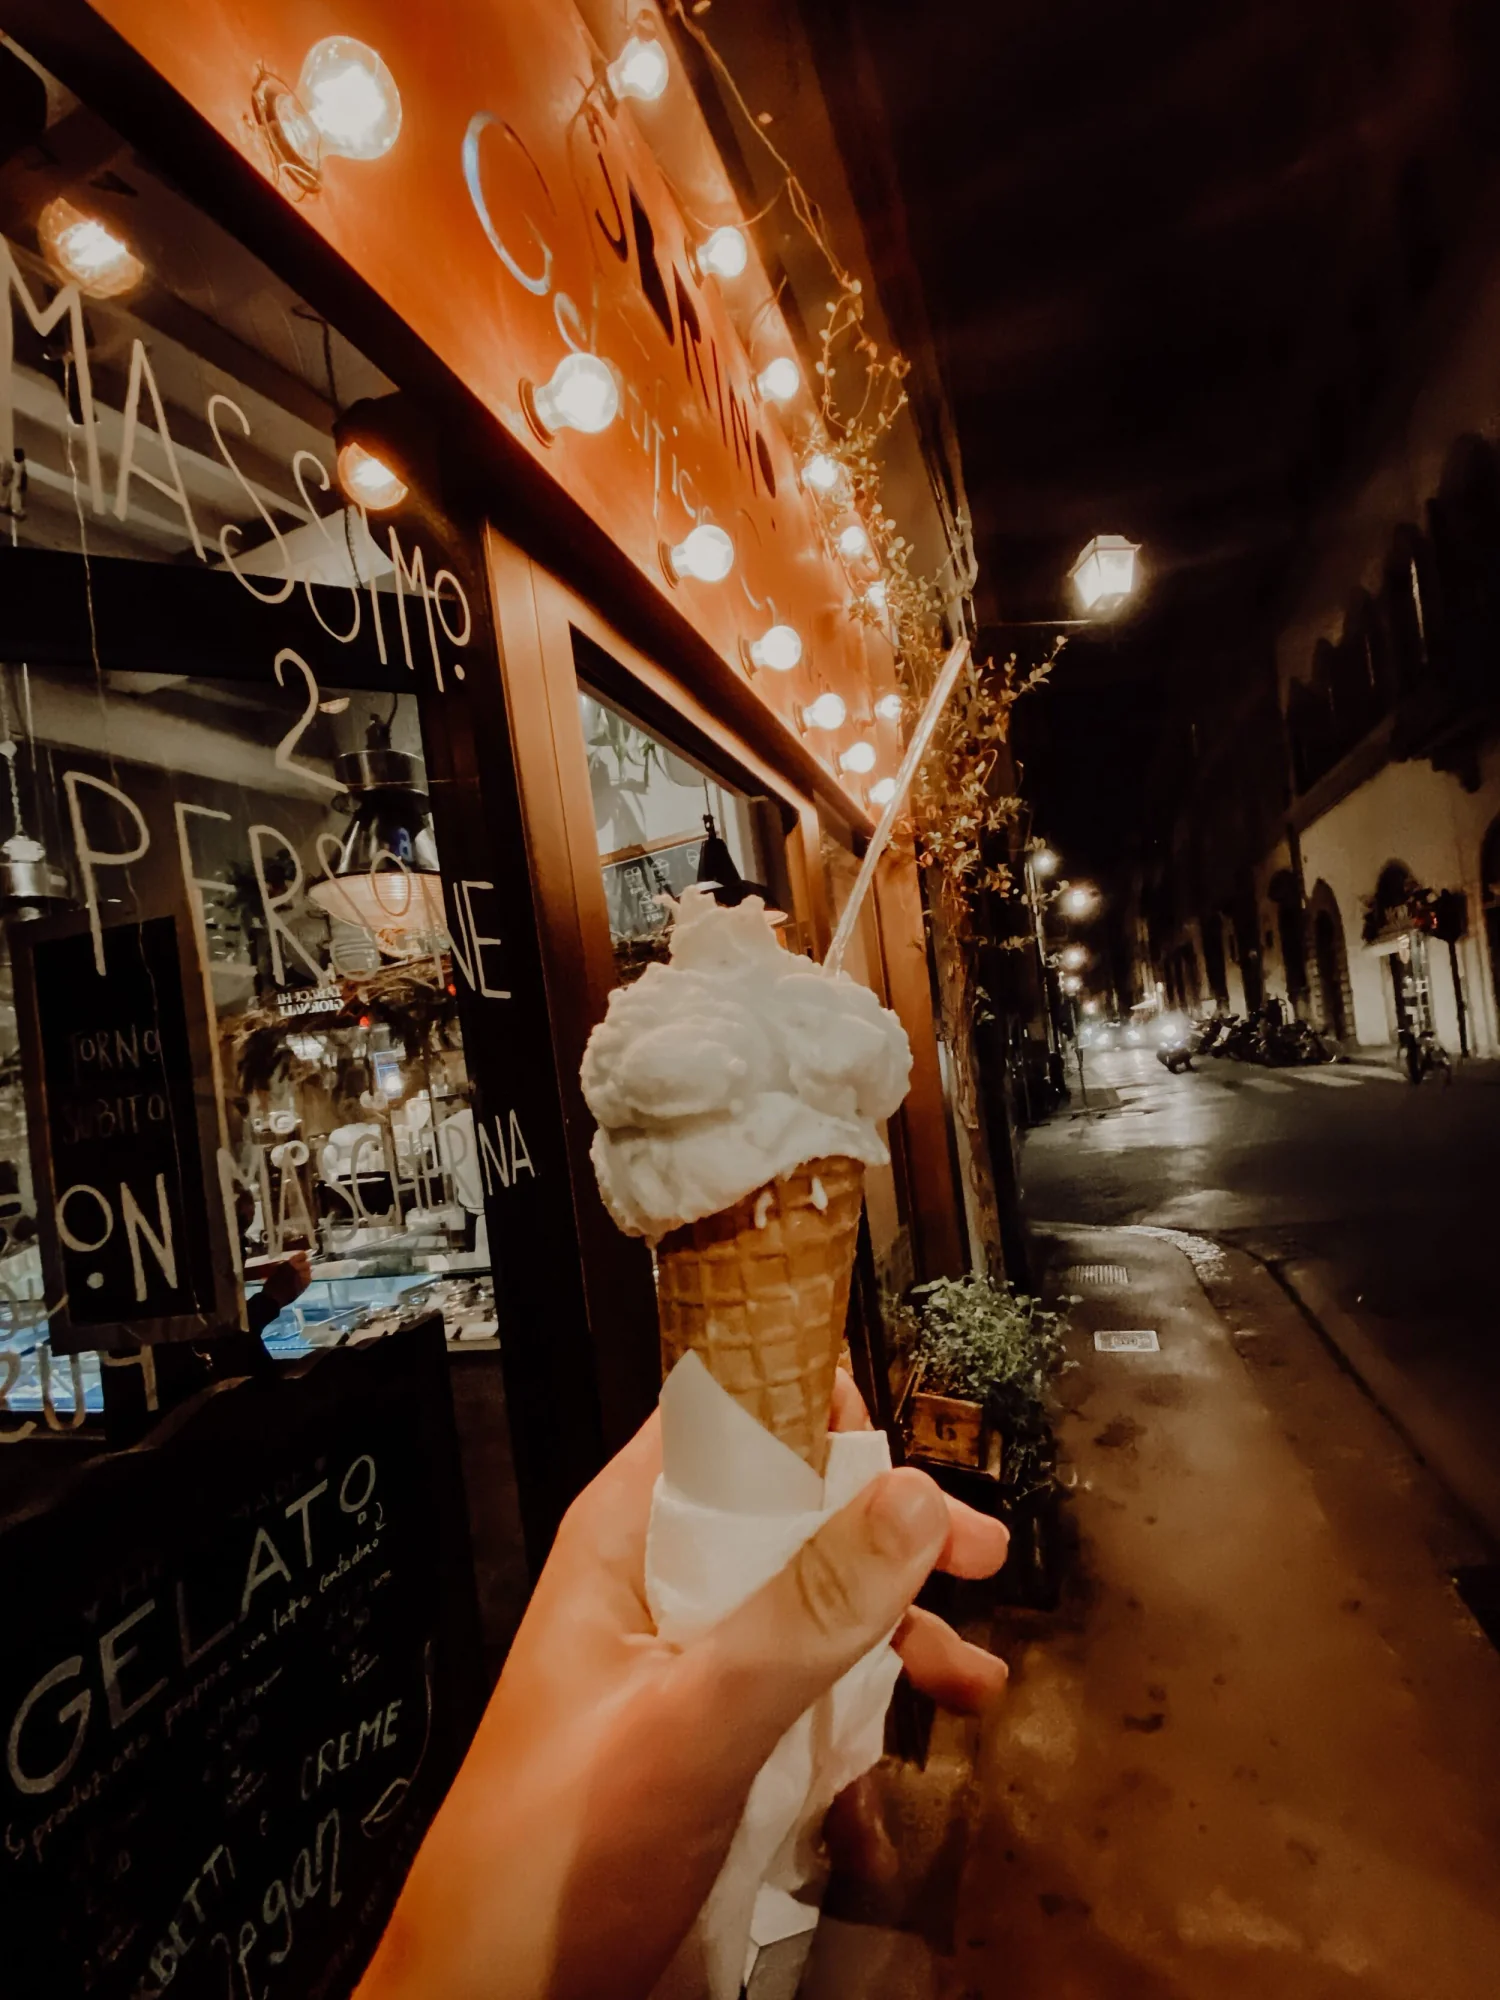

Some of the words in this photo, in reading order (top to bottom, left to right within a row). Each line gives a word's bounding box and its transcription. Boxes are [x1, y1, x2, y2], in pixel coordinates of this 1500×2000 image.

[274, 647, 348, 794] 2
[64, 770, 512, 999] PERSONE
[7, 1454, 376, 1794] GELATO
[300, 1699, 404, 1802] CREME
